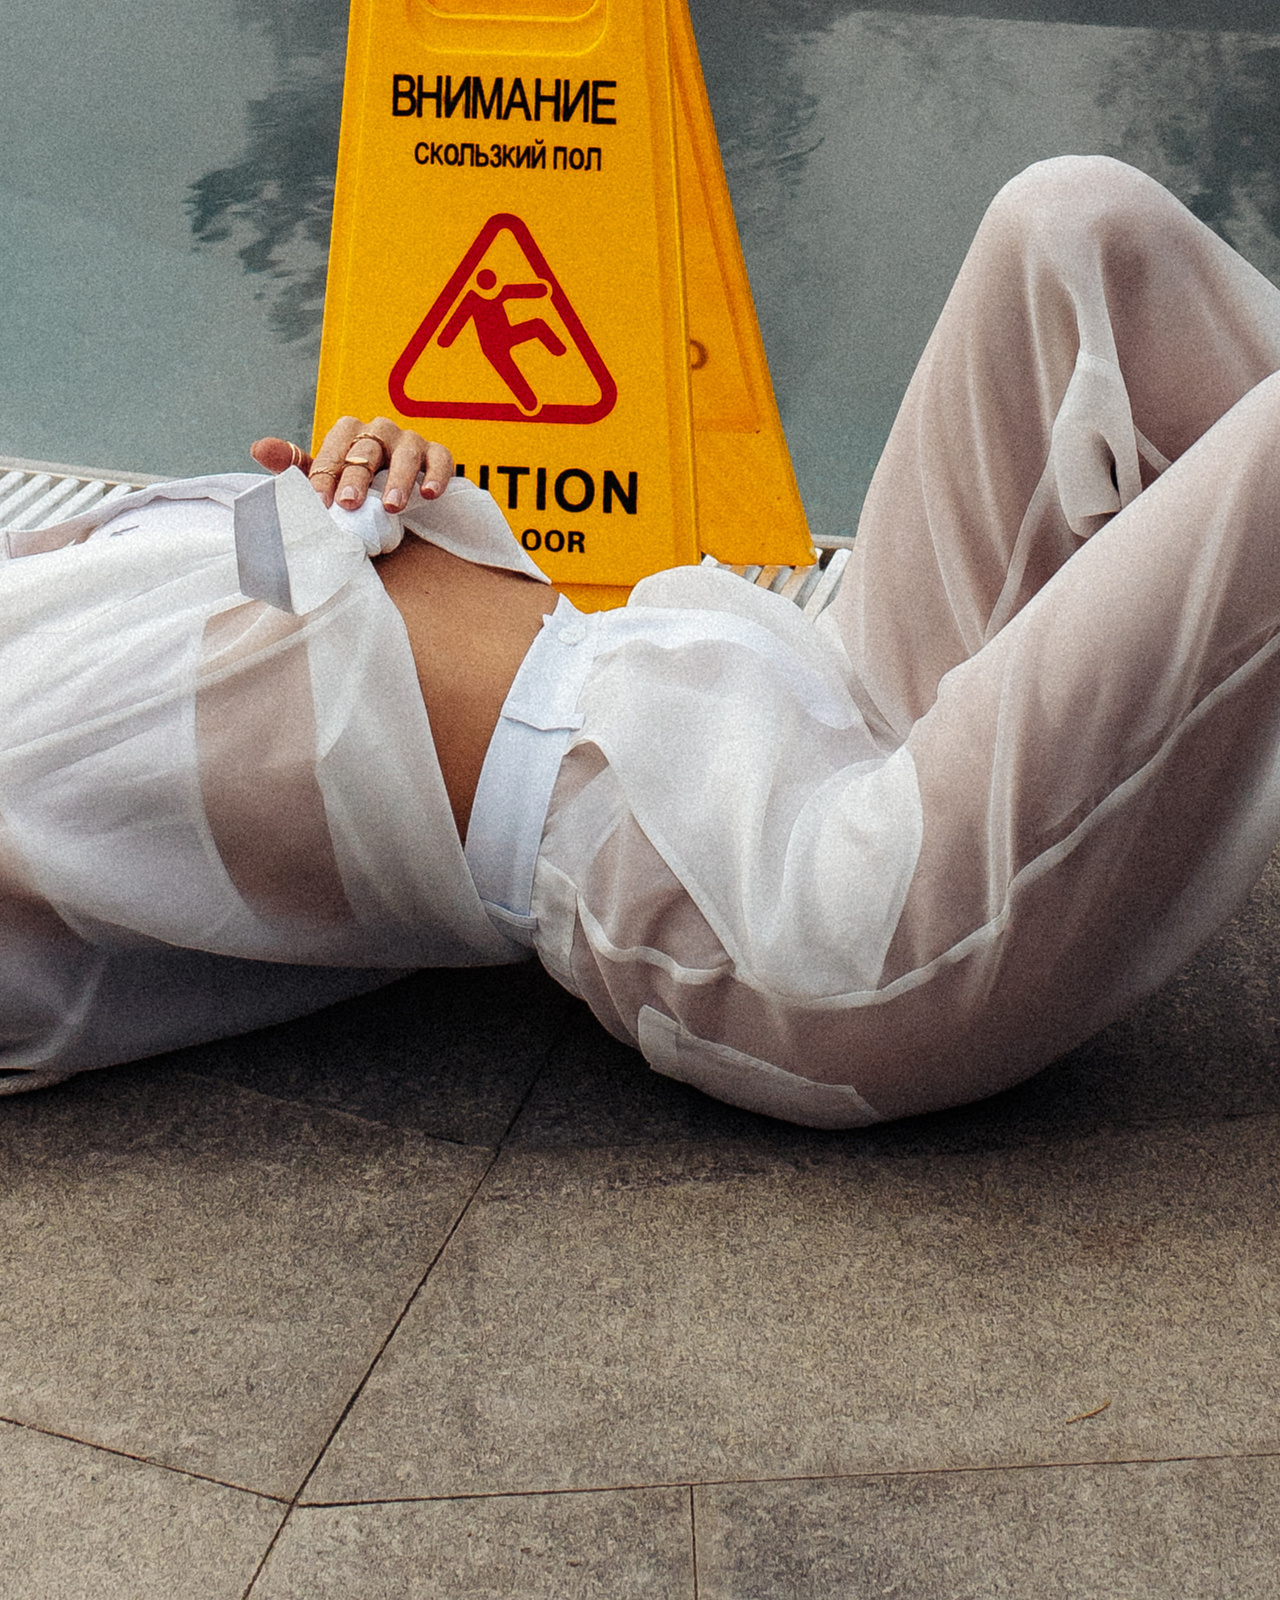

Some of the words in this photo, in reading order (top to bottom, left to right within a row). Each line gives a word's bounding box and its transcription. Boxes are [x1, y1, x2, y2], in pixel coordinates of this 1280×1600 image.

[392, 73, 617, 125] ВНИМАНИЕ
[449, 463, 638, 515] TION
[521, 528, 586, 554] OOR
